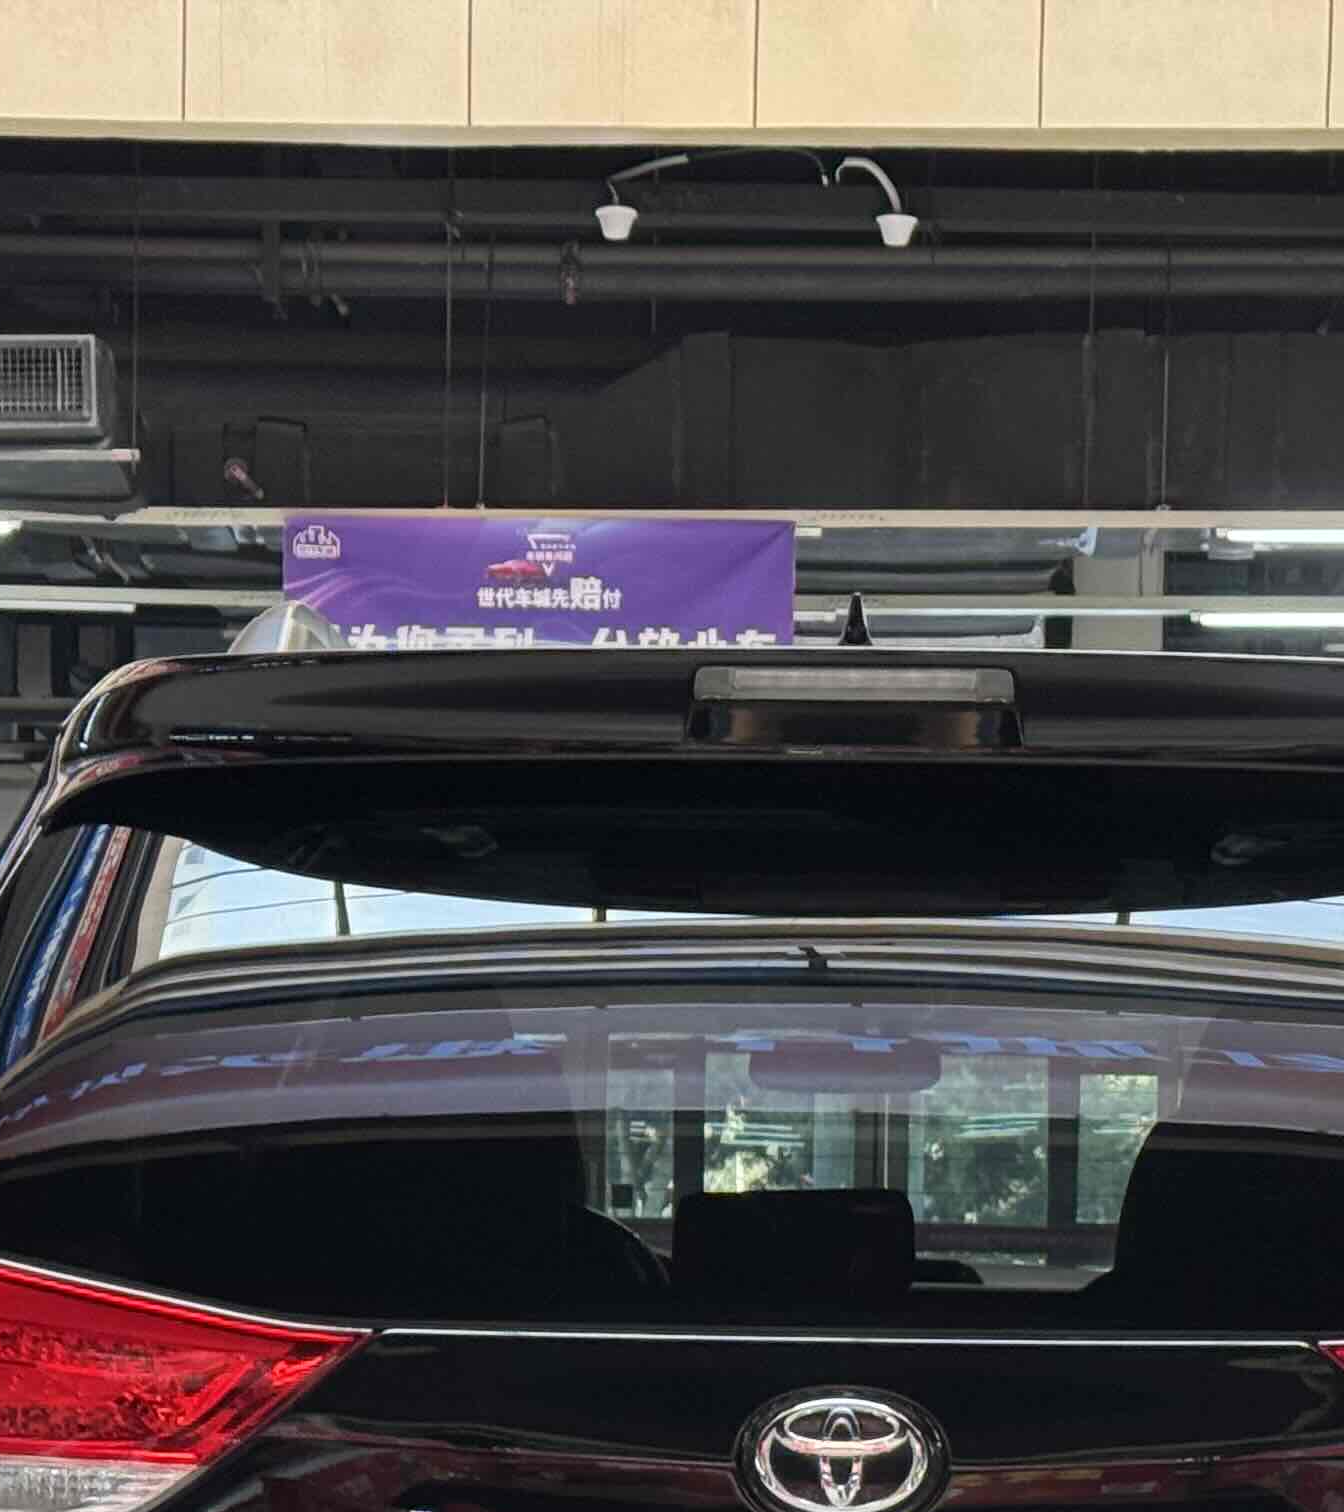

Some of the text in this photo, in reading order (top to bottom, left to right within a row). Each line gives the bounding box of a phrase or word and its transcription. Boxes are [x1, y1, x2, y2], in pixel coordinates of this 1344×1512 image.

[477, 576, 622, 612] 世代车城先赔付
